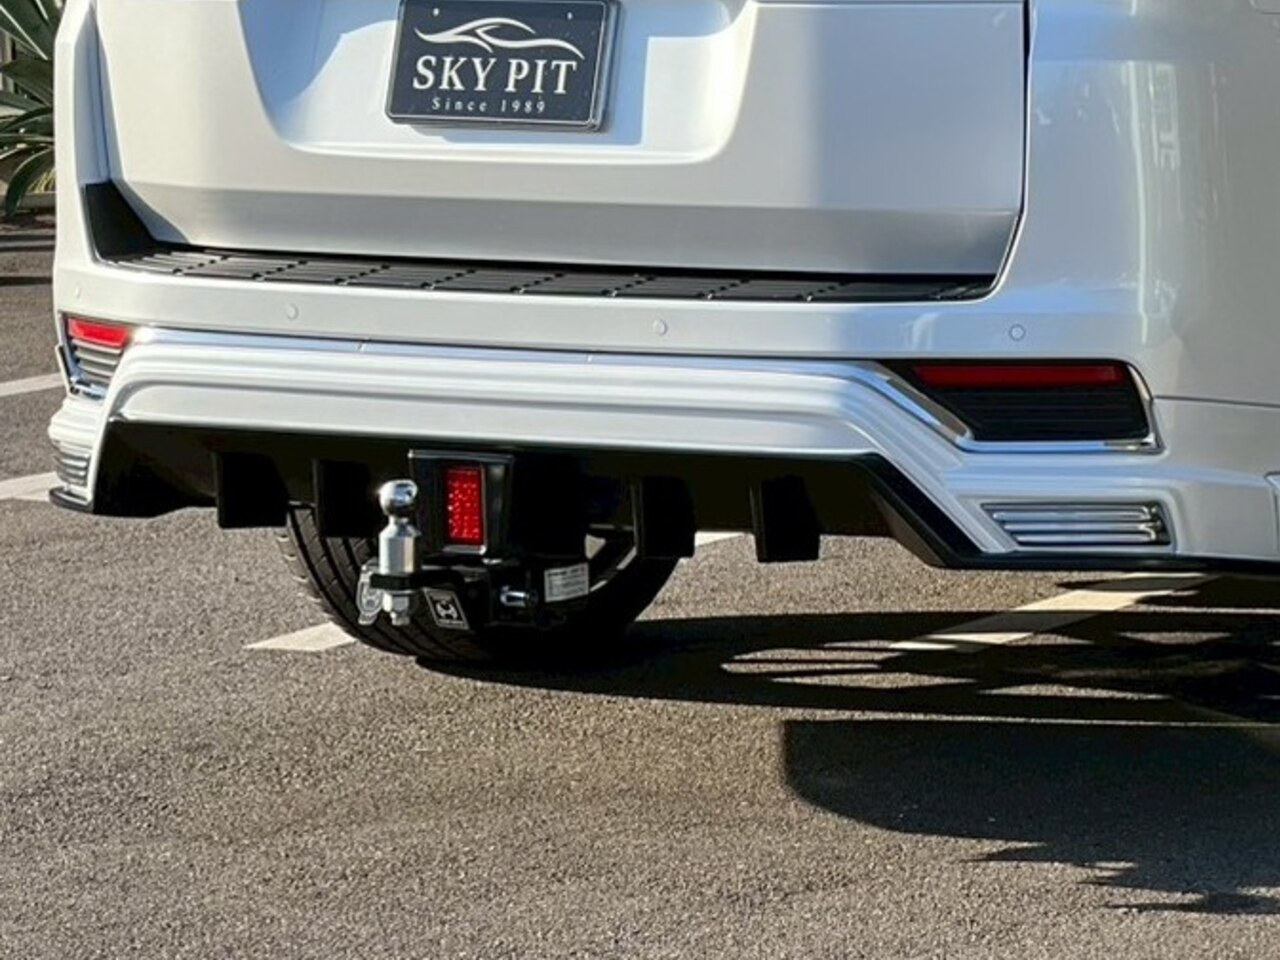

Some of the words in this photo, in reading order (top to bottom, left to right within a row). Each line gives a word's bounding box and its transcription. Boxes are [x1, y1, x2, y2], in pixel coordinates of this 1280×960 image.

[412, 54, 498, 92] SKY
[504, 58, 578, 95] PIT
[431, 96, 488, 113] Since
[500, 99, 546, 114] 1989
